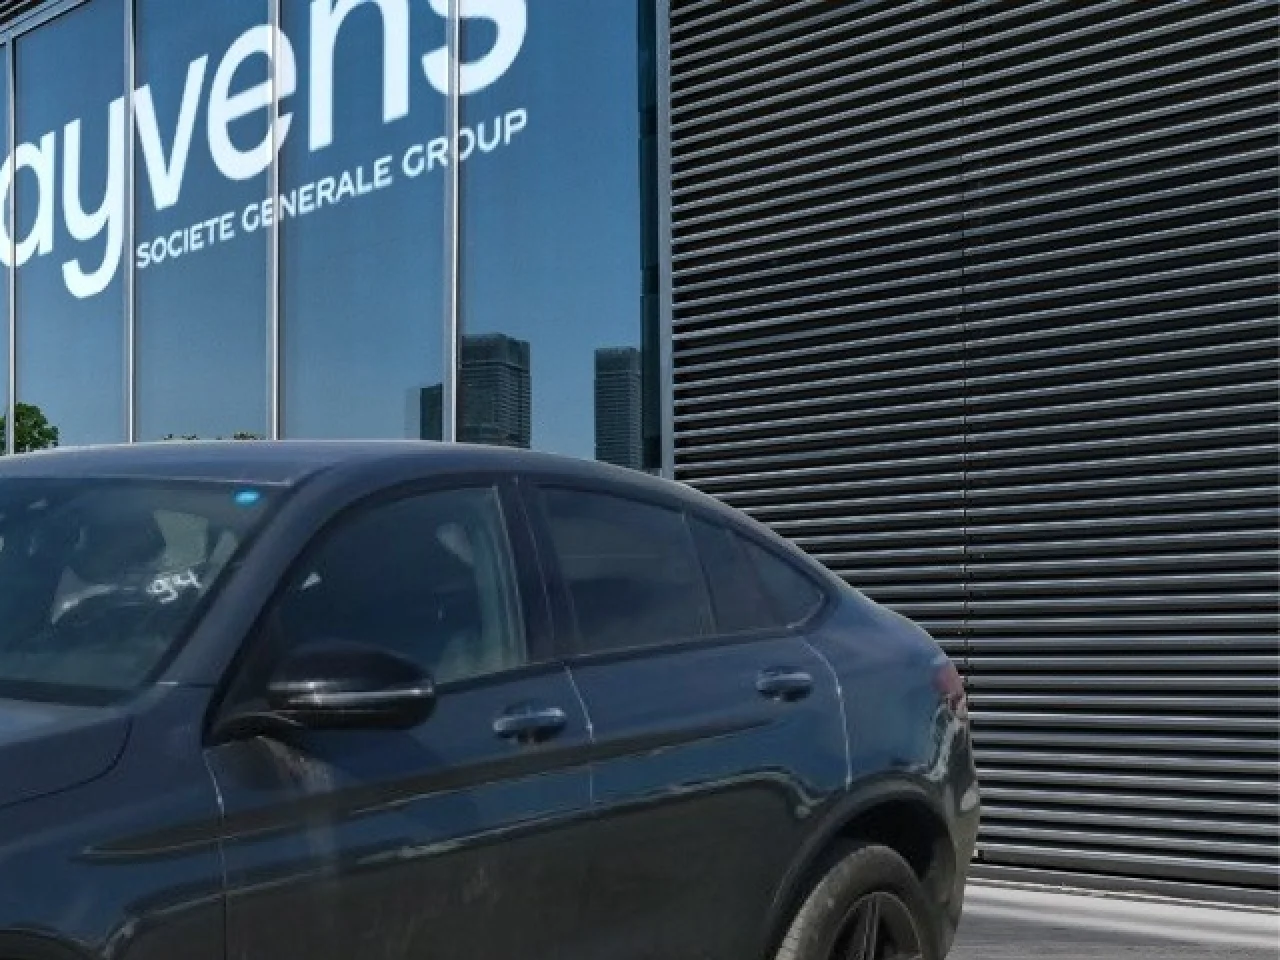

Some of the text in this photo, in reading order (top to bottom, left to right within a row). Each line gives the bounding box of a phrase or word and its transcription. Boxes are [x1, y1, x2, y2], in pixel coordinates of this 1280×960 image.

[135, 107, 527, 269] SOCIETE GENERALE GROUP
